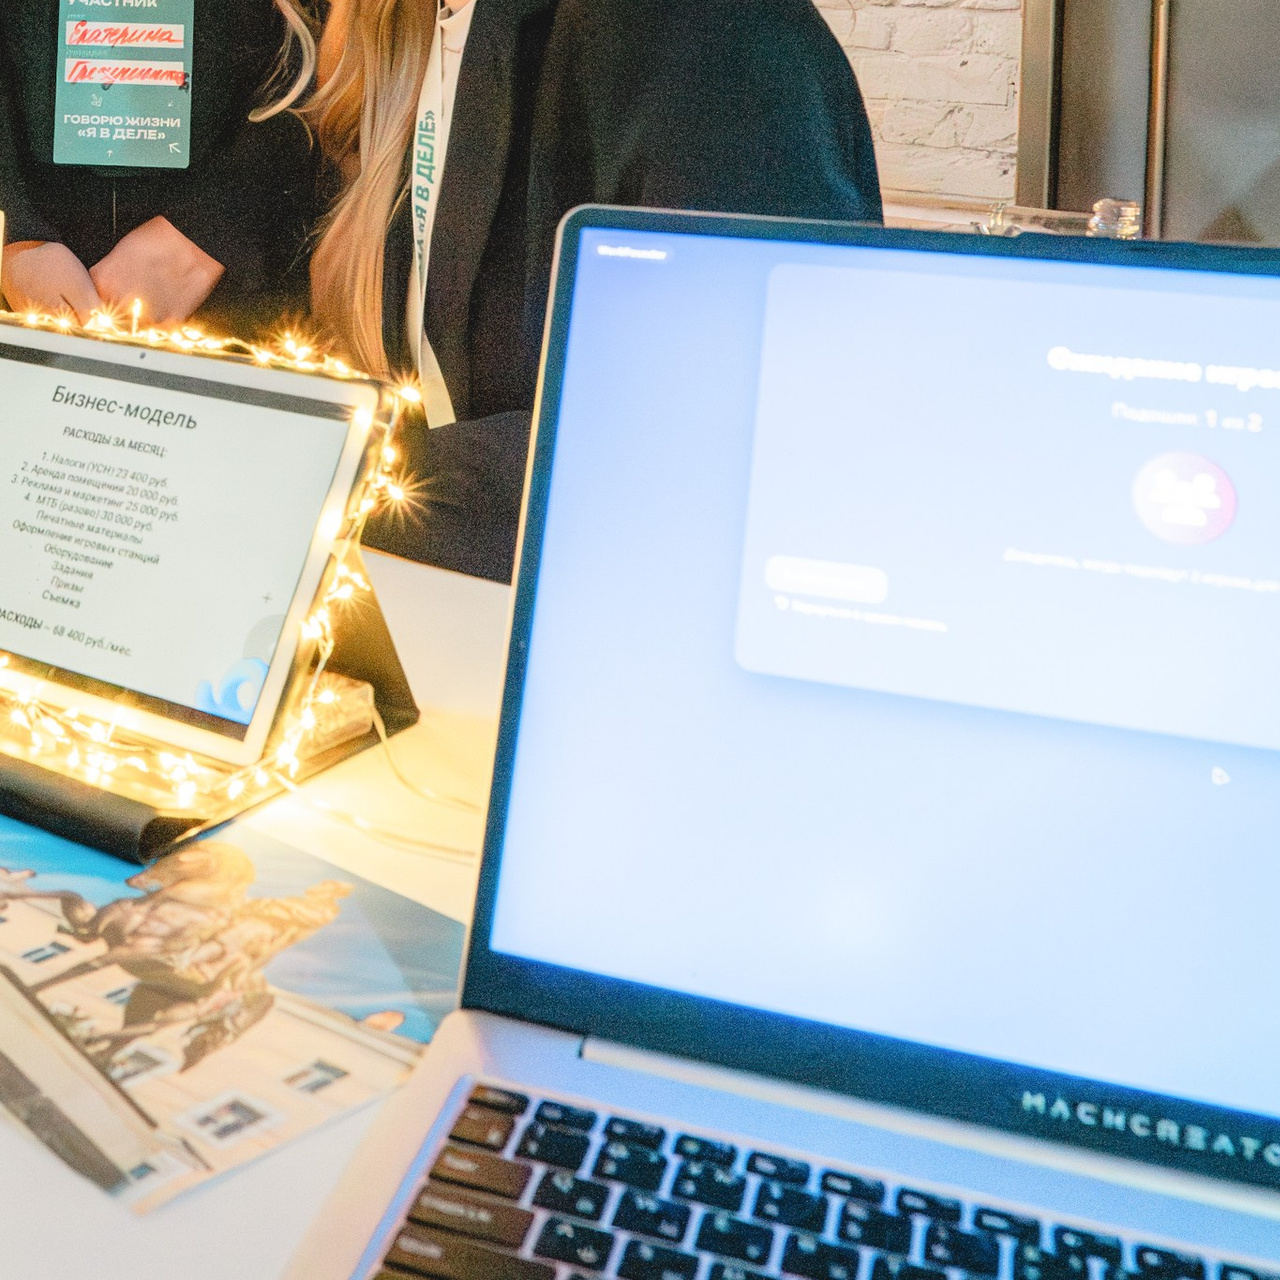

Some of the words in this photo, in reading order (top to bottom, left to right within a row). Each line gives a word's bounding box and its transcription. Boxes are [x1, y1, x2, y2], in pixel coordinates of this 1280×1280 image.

[63, 114, 123, 127] ГОВОРЮ
[125, 116, 181, 128] ЖИЗНИ
[99, 128, 110, 139] В
[112, 128, 166, 141] ДЕЛЕ»
[416, 110, 436, 184] ДЕЛЕ»
[415, 186, 429, 202] В
[52, 385, 198, 430] Бизнес-модель
[62, 426, 112, 445] РАСХОДЫ
[112, 436, 125, 448] ЗА
[51, 453, 86, 469] Налоги
[115, 468, 129, 480] 23
[130, 471, 149, 483] 400
[30, 464, 66, 481] Аренда
[67, 473, 125, 494] помещения
[125, 484, 139, 497] 20
[139, 488, 160, 502] 000
[20, 476, 63, 494] Реклама
[72, 491, 125, 509] маркетинг
[125, 500, 139, 512] 25
[139, 504, 160, 517] 000
[36, 509, 85, 531] Печатные
[86, 524, 144, 545] материалы
[100, 509, 114, 522] 30
[114, 513, 134, 527] 000
[12, 519, 73, 543] Оформление
[73, 536, 116, 555] игровых
[117, 546, 160, 565] станций
[44, 543, 114, 569] Оборудование
[51, 560, 94, 580] Задания
[50, 575, 85, 593] Призы
[41, 589, 81, 609] Съемка
[66, 628, 86, 643] 400
